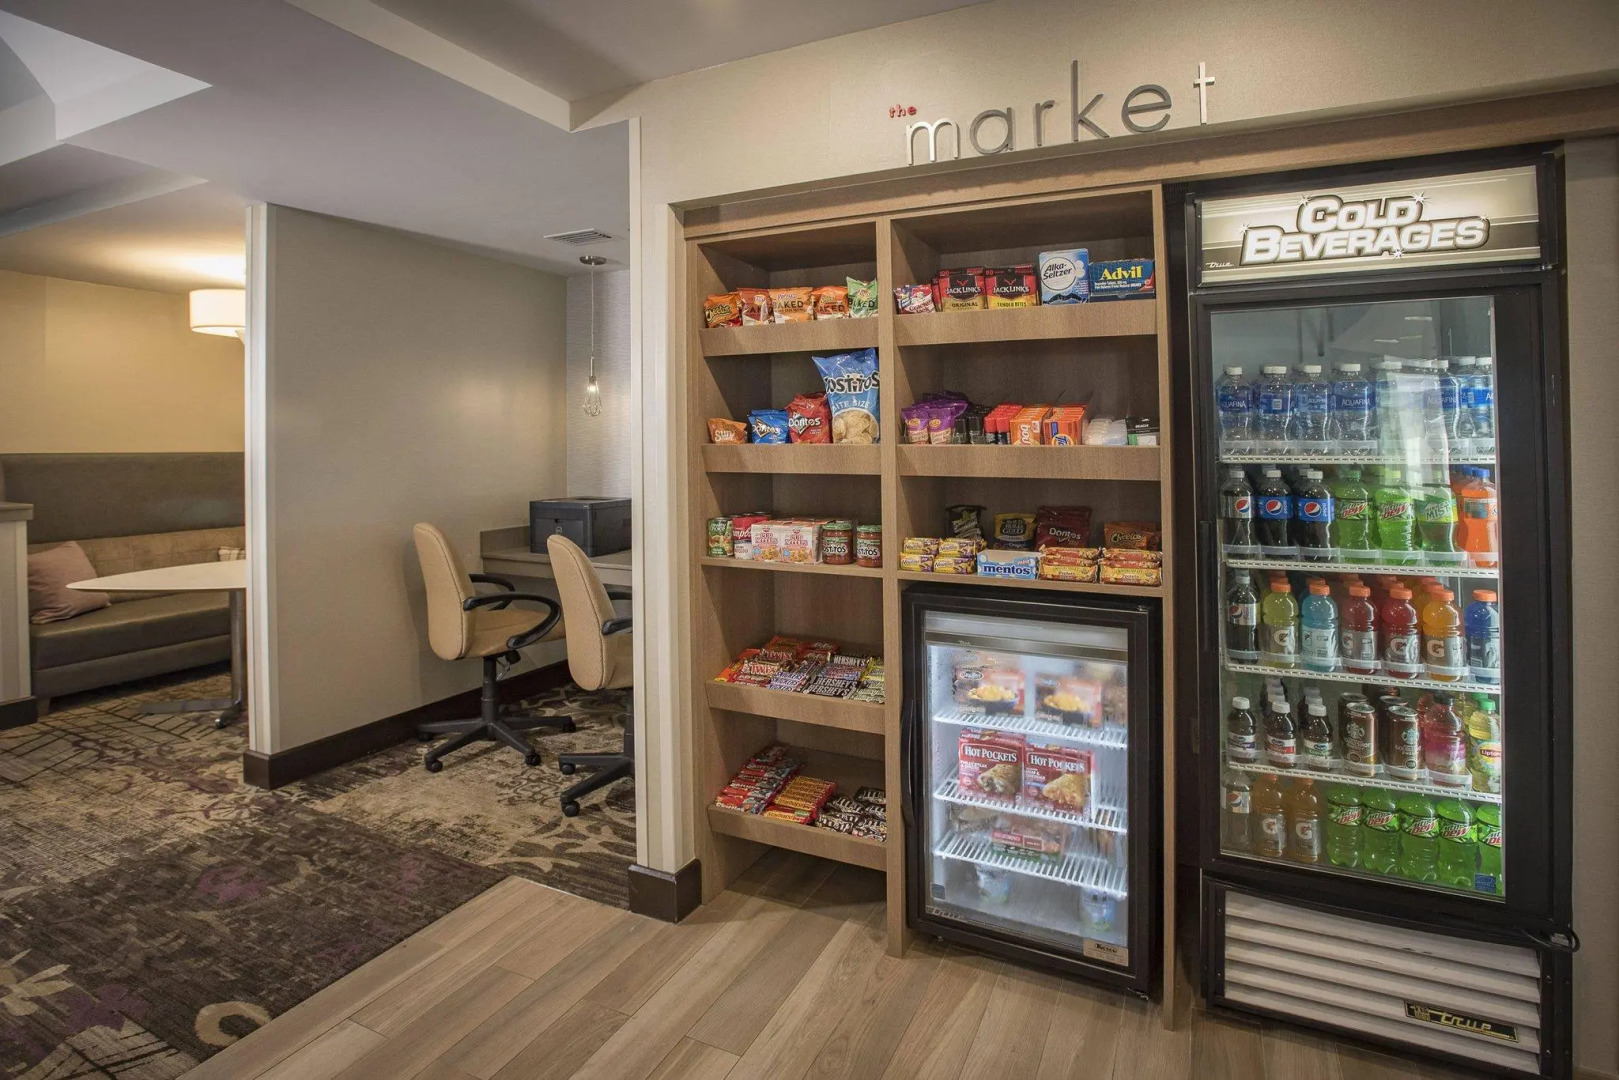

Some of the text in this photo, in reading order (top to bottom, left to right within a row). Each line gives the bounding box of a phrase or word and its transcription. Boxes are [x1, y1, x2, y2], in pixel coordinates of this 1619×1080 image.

[889, 105, 917, 119] the
[906, 59, 1215, 166] market
[1299, 196, 1421, 232] COLD
[1242, 218, 1489, 264] BEVERAGES
[1042, 267, 1073, 281] Seltzer
[1044, 262, 1067, 273] Alka-
[1099, 265, 1144, 281] Advil
[946, 286, 962, 294] JACK
[993, 286, 1009, 294] JACK
[773, 300, 804, 309] BAKED
[818, 304, 846, 313] AKED
[788, 416, 822, 428] Doritos
[1426, 503, 1449, 520] MIST
[1049, 527, 1082, 540] Doritos
[1110, 532, 1143, 543] Cheetos
[983, 565, 1031, 576] mentos
[1426, 639, 1445, 658] G
[750, 661, 778, 676] TWIX
[814, 677, 857, 689] HERSHEY'S
[807, 685, 850, 697] HERSHEY'S
[965, 746, 1018, 763] HOT POCKETS
[1030, 754, 1086, 773] HOT POCKETS
[1441, 1012, 1492, 1033] true
